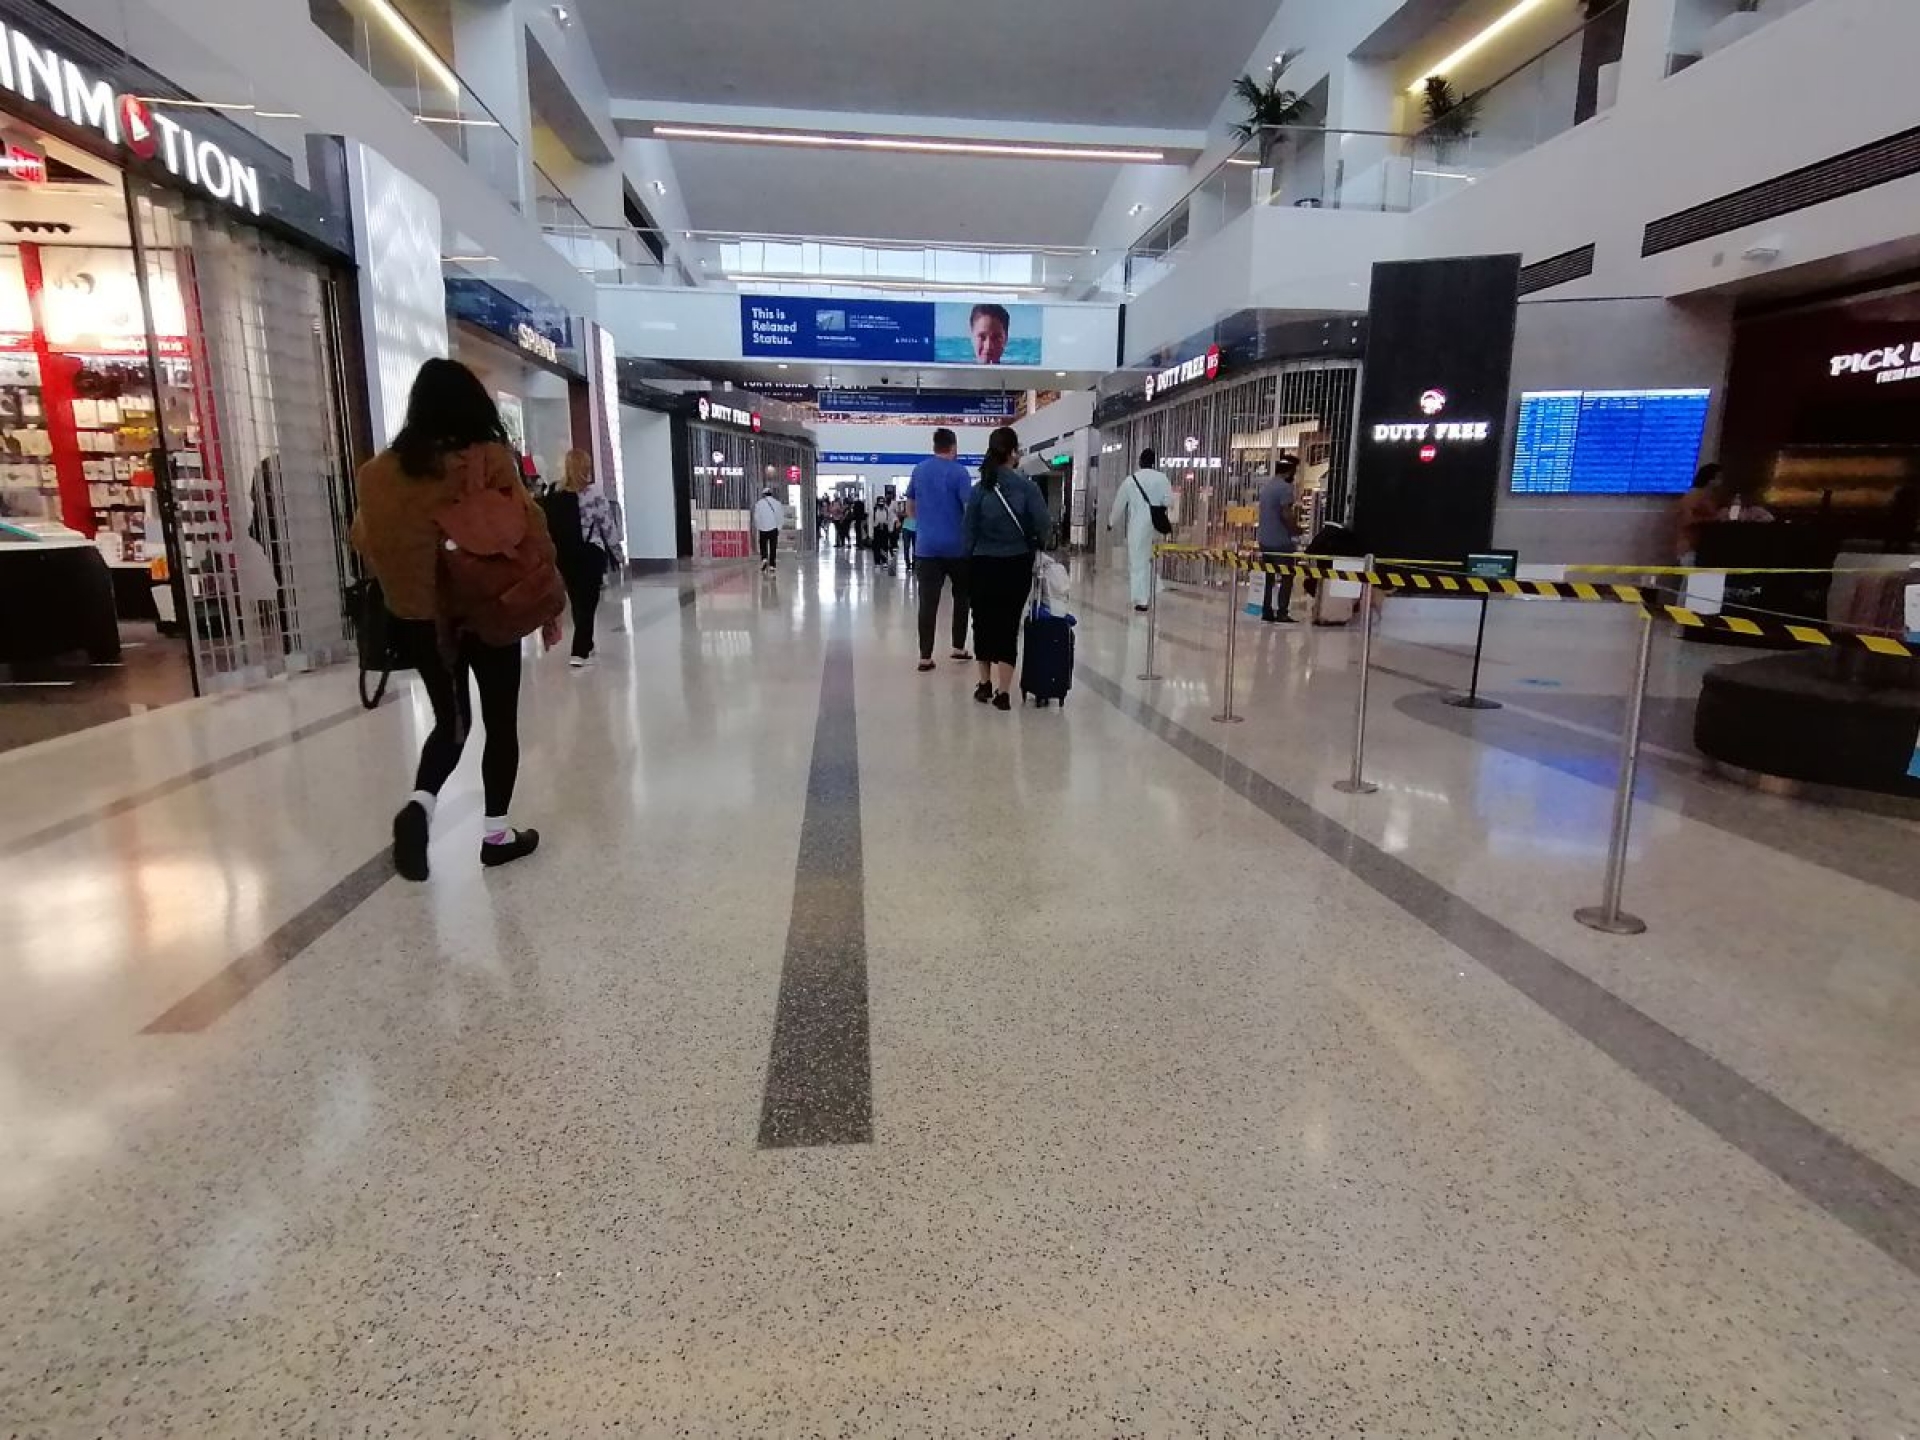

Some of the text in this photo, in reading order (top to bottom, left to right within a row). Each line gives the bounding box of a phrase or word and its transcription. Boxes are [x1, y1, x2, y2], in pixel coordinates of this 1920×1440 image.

[752, 307, 786, 320] This is
[752, 320, 797, 333] Relaxed
[753, 333, 792, 345] Status.
[1829, 343, 1905, 376] PICK
[1157, 365, 1180, 393] DUTY
[1181, 354, 1206, 382] FREE
[711, 402, 732, 422] DUTY
[1373, 422, 1488, 441] DUTY FREE
